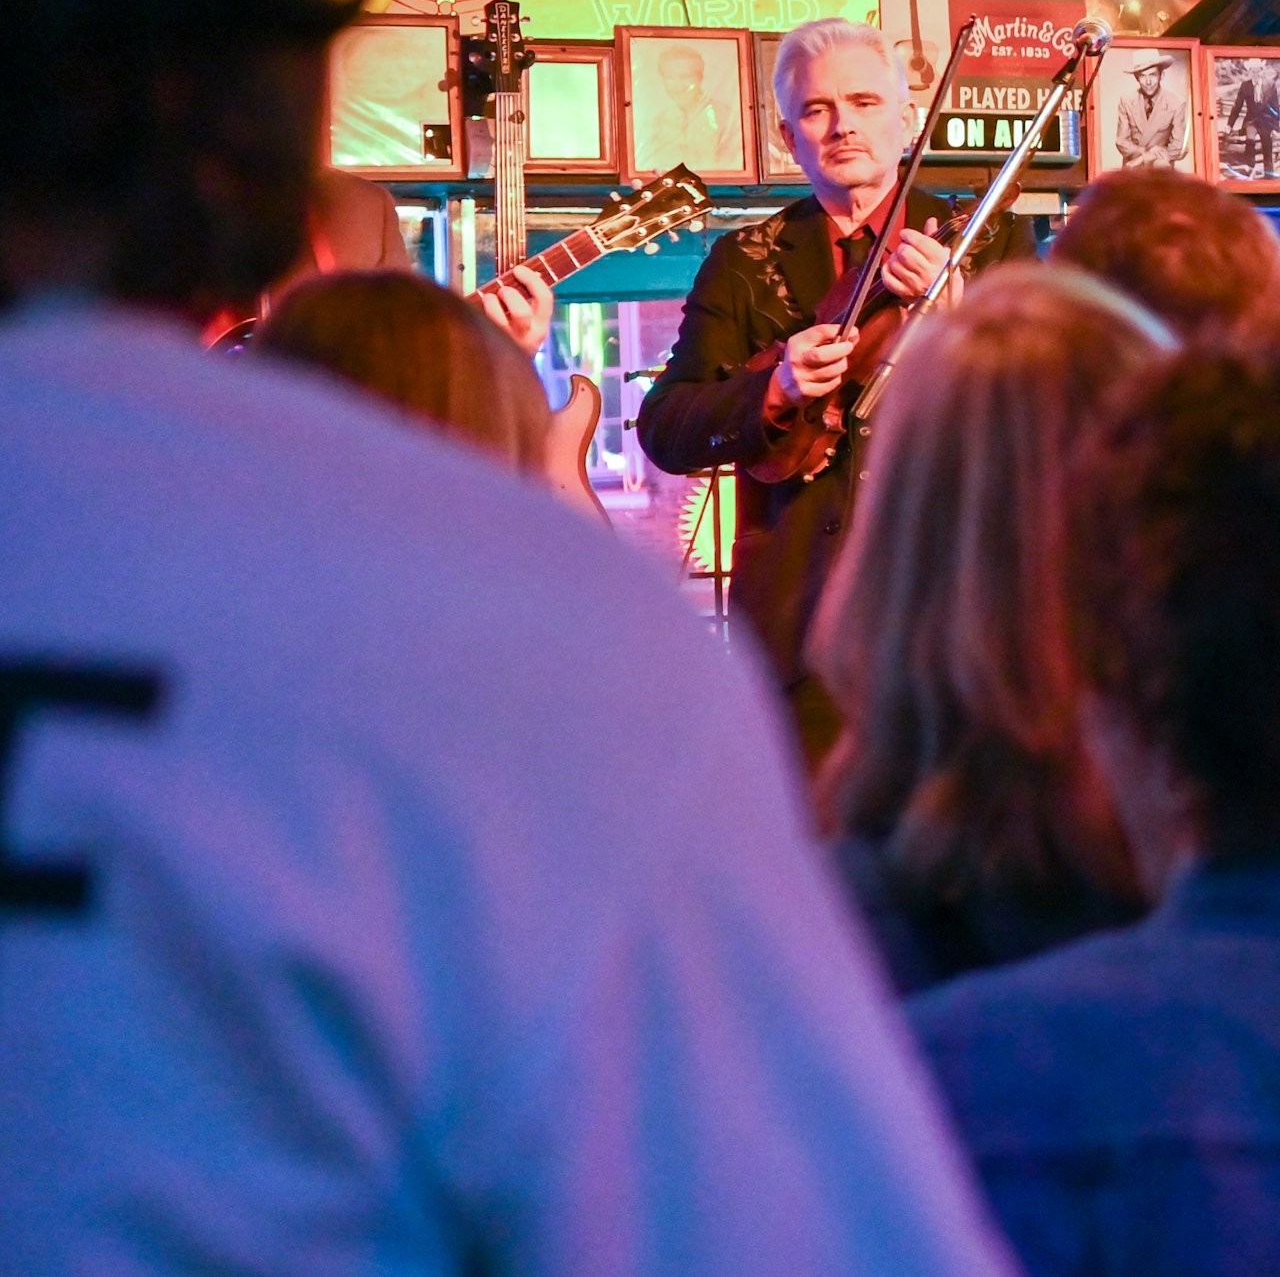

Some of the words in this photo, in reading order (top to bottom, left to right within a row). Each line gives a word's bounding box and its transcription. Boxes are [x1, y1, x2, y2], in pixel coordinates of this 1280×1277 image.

[991, 45, 1017, 57] EST.
[1021, 46, 1050, 58] 1833
[959, 86, 1031, 110] PLAYED
[1037, 87, 1084, 112] HRE
[946, 117, 985, 148] ON
